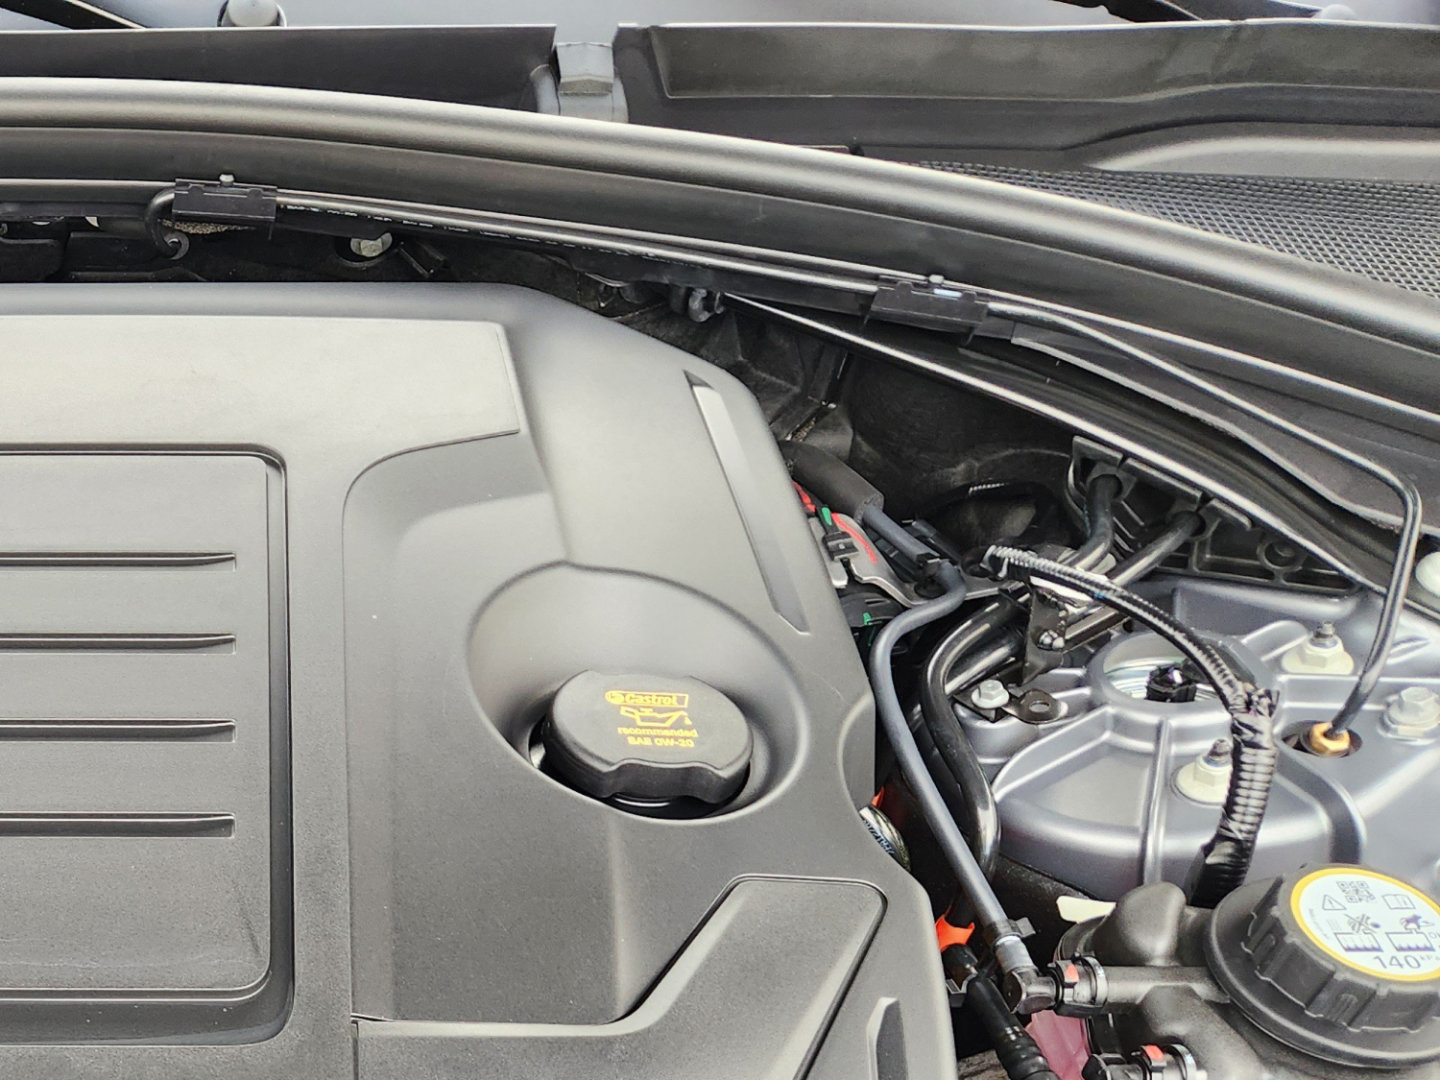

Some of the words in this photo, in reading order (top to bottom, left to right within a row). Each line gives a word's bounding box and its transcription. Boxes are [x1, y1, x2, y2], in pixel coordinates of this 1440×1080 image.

[624, 692, 678, 706] Castrol
[617, 726, 699, 738] recommended
[626, 735, 653, 746] SAE
[1373, 955, 1422, 969] 140
